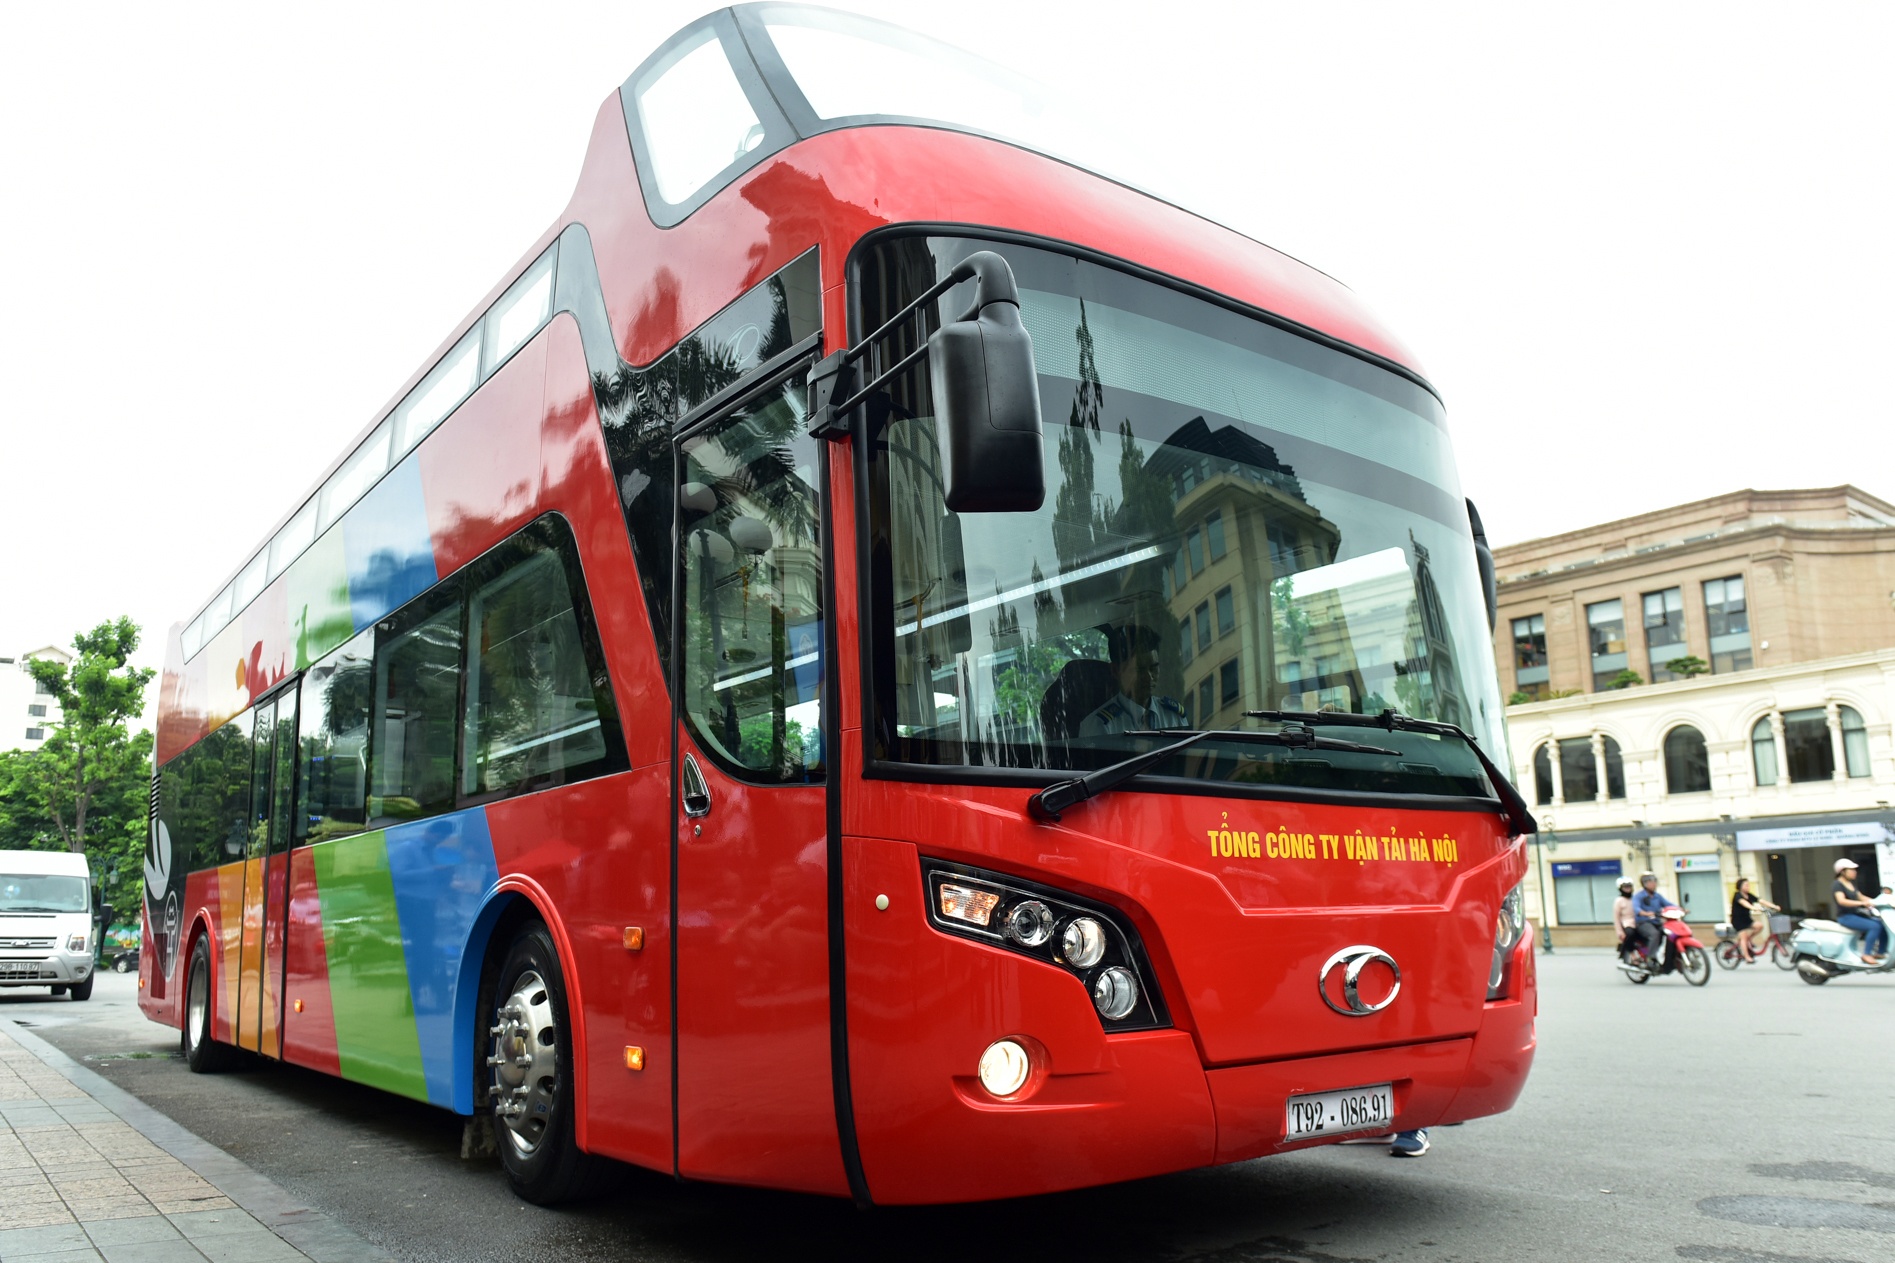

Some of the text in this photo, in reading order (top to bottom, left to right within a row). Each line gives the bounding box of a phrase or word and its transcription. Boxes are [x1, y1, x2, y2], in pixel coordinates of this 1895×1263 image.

[1207, 811, 1458, 868] TỔNG CÔNG TY VẬN TẢI HÀ NỘI
